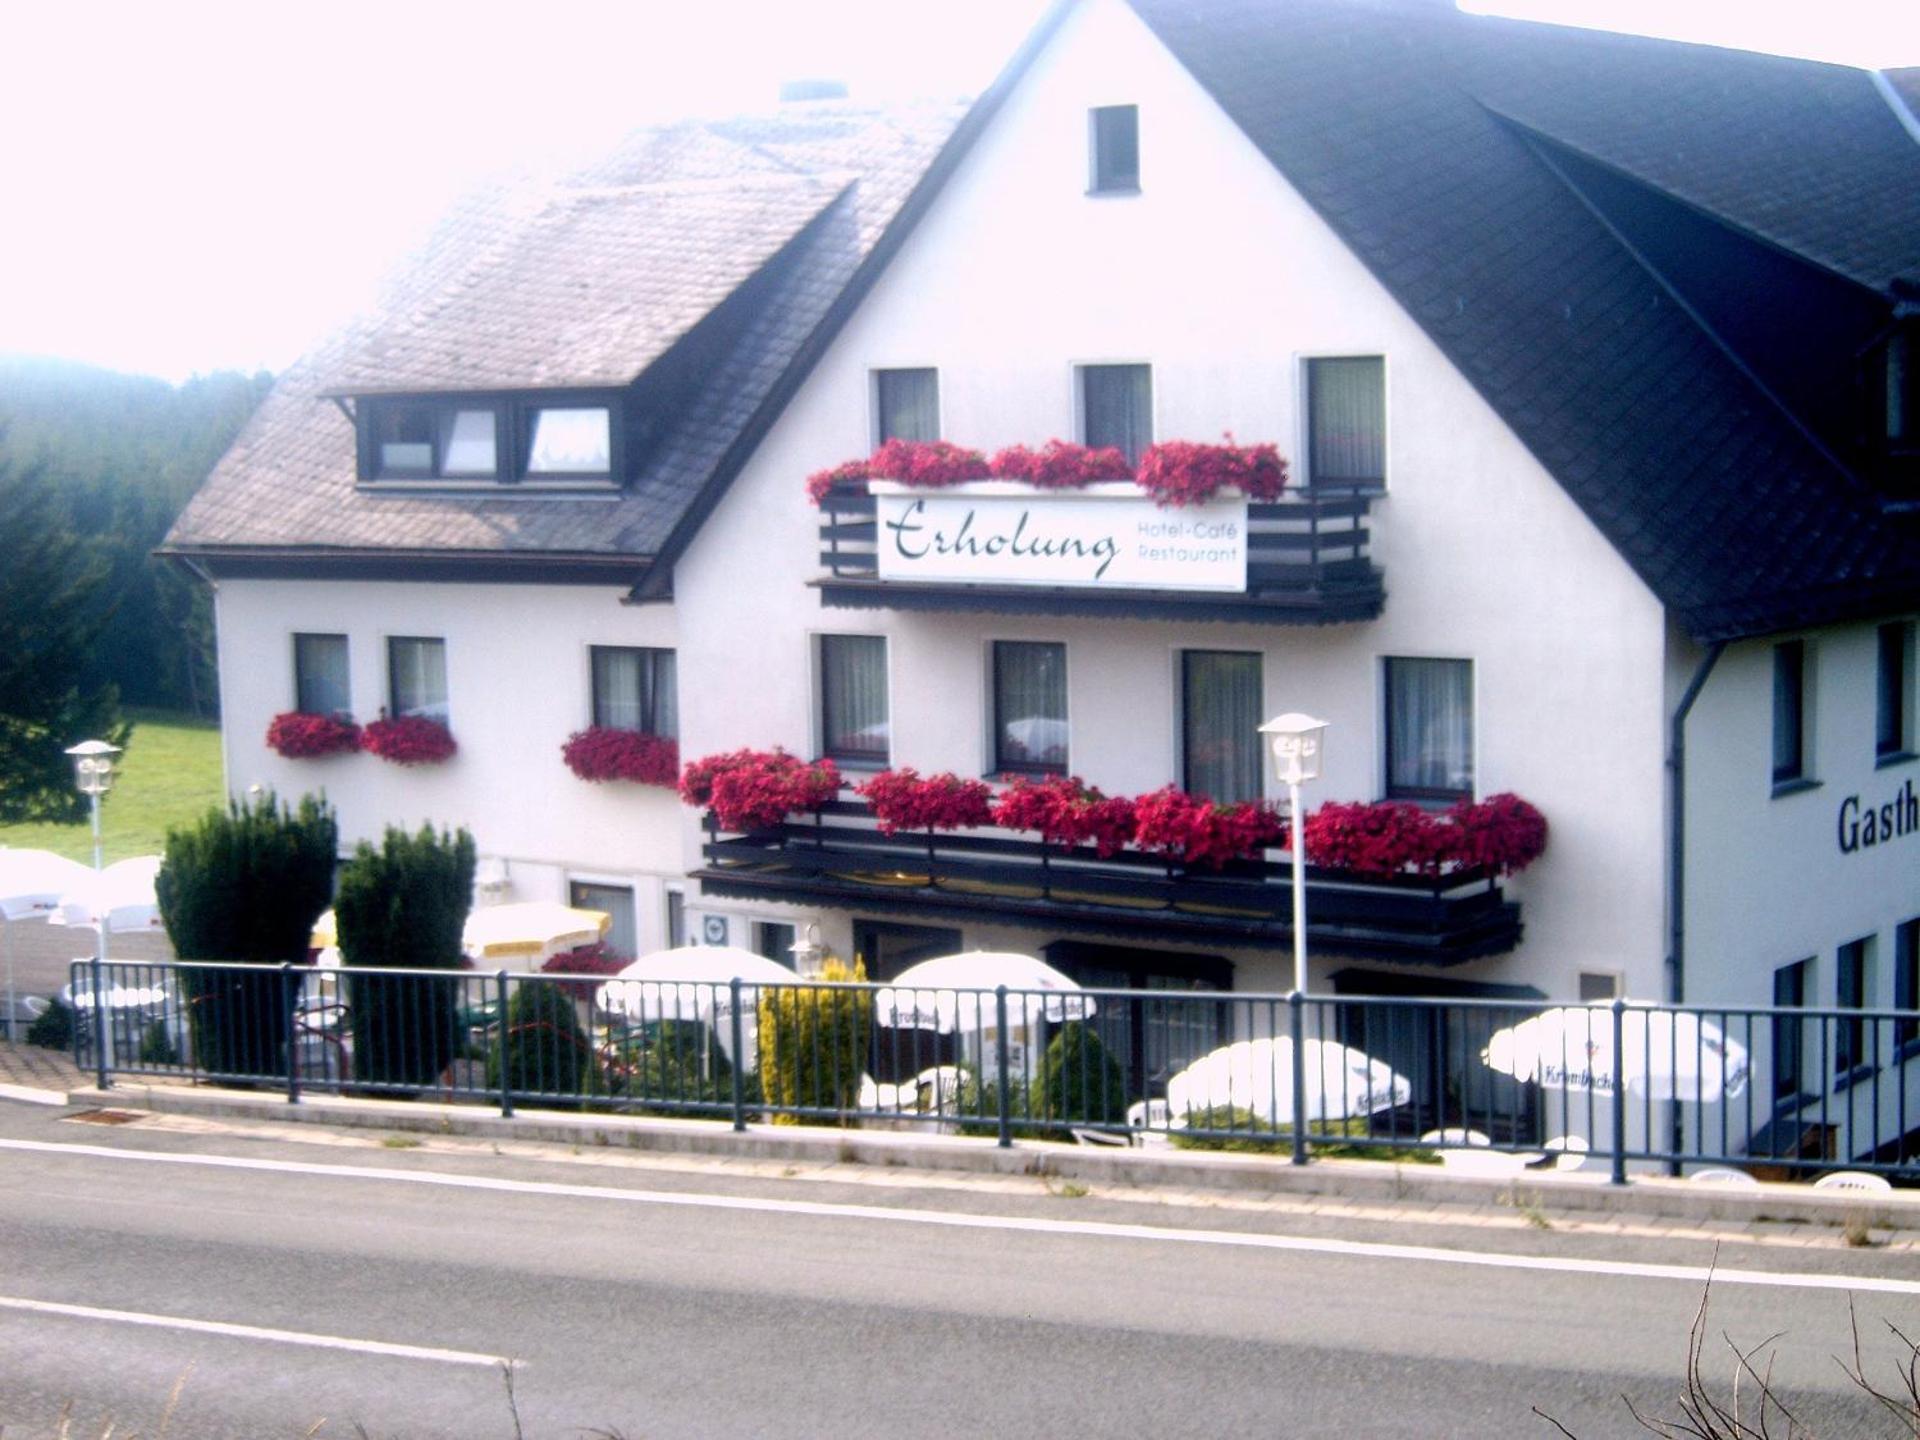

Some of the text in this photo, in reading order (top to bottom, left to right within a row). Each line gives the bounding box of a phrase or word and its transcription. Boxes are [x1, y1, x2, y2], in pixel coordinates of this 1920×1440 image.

[886, 499, 1120, 579] Erholung
[1138, 545, 1236, 561] Restaurant
[1838, 779, 1919, 855] Gasth
